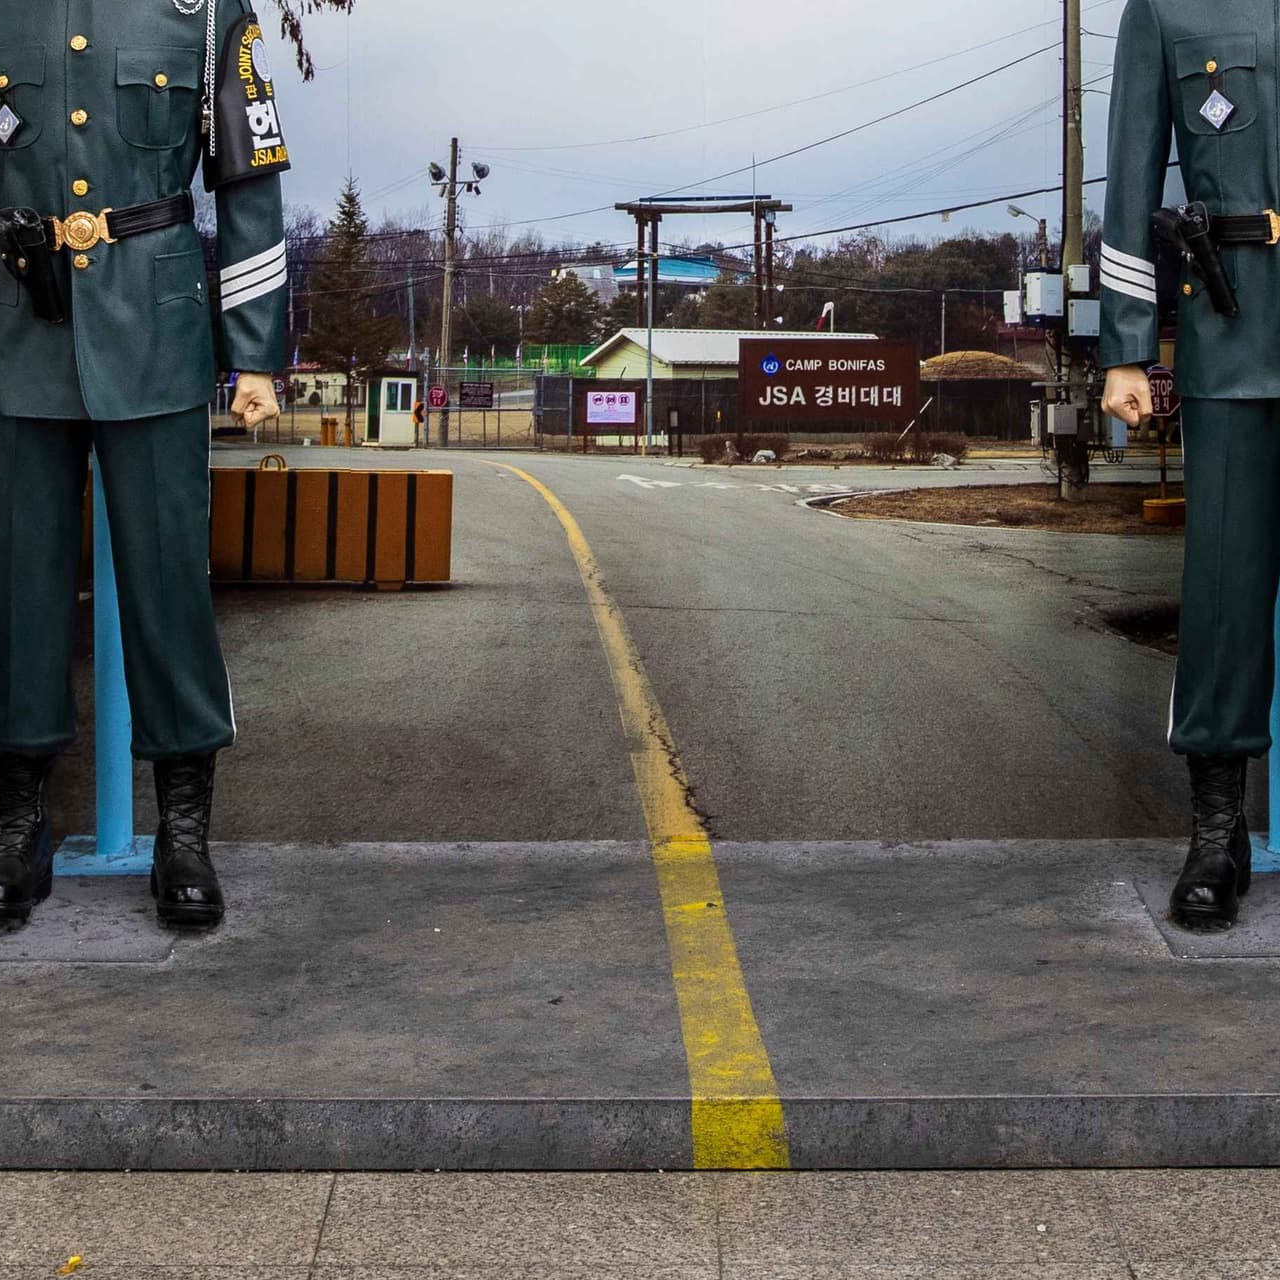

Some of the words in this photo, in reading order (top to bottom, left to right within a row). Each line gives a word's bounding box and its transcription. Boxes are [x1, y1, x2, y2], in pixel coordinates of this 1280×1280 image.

[785, 359, 822, 371] CAMP
[828, 359, 886, 371] BONIFAS
[1150, 379, 1173, 396] STOP
[758, 385, 806, 407] JSA
[814, 385, 902, 408] 경비대대
